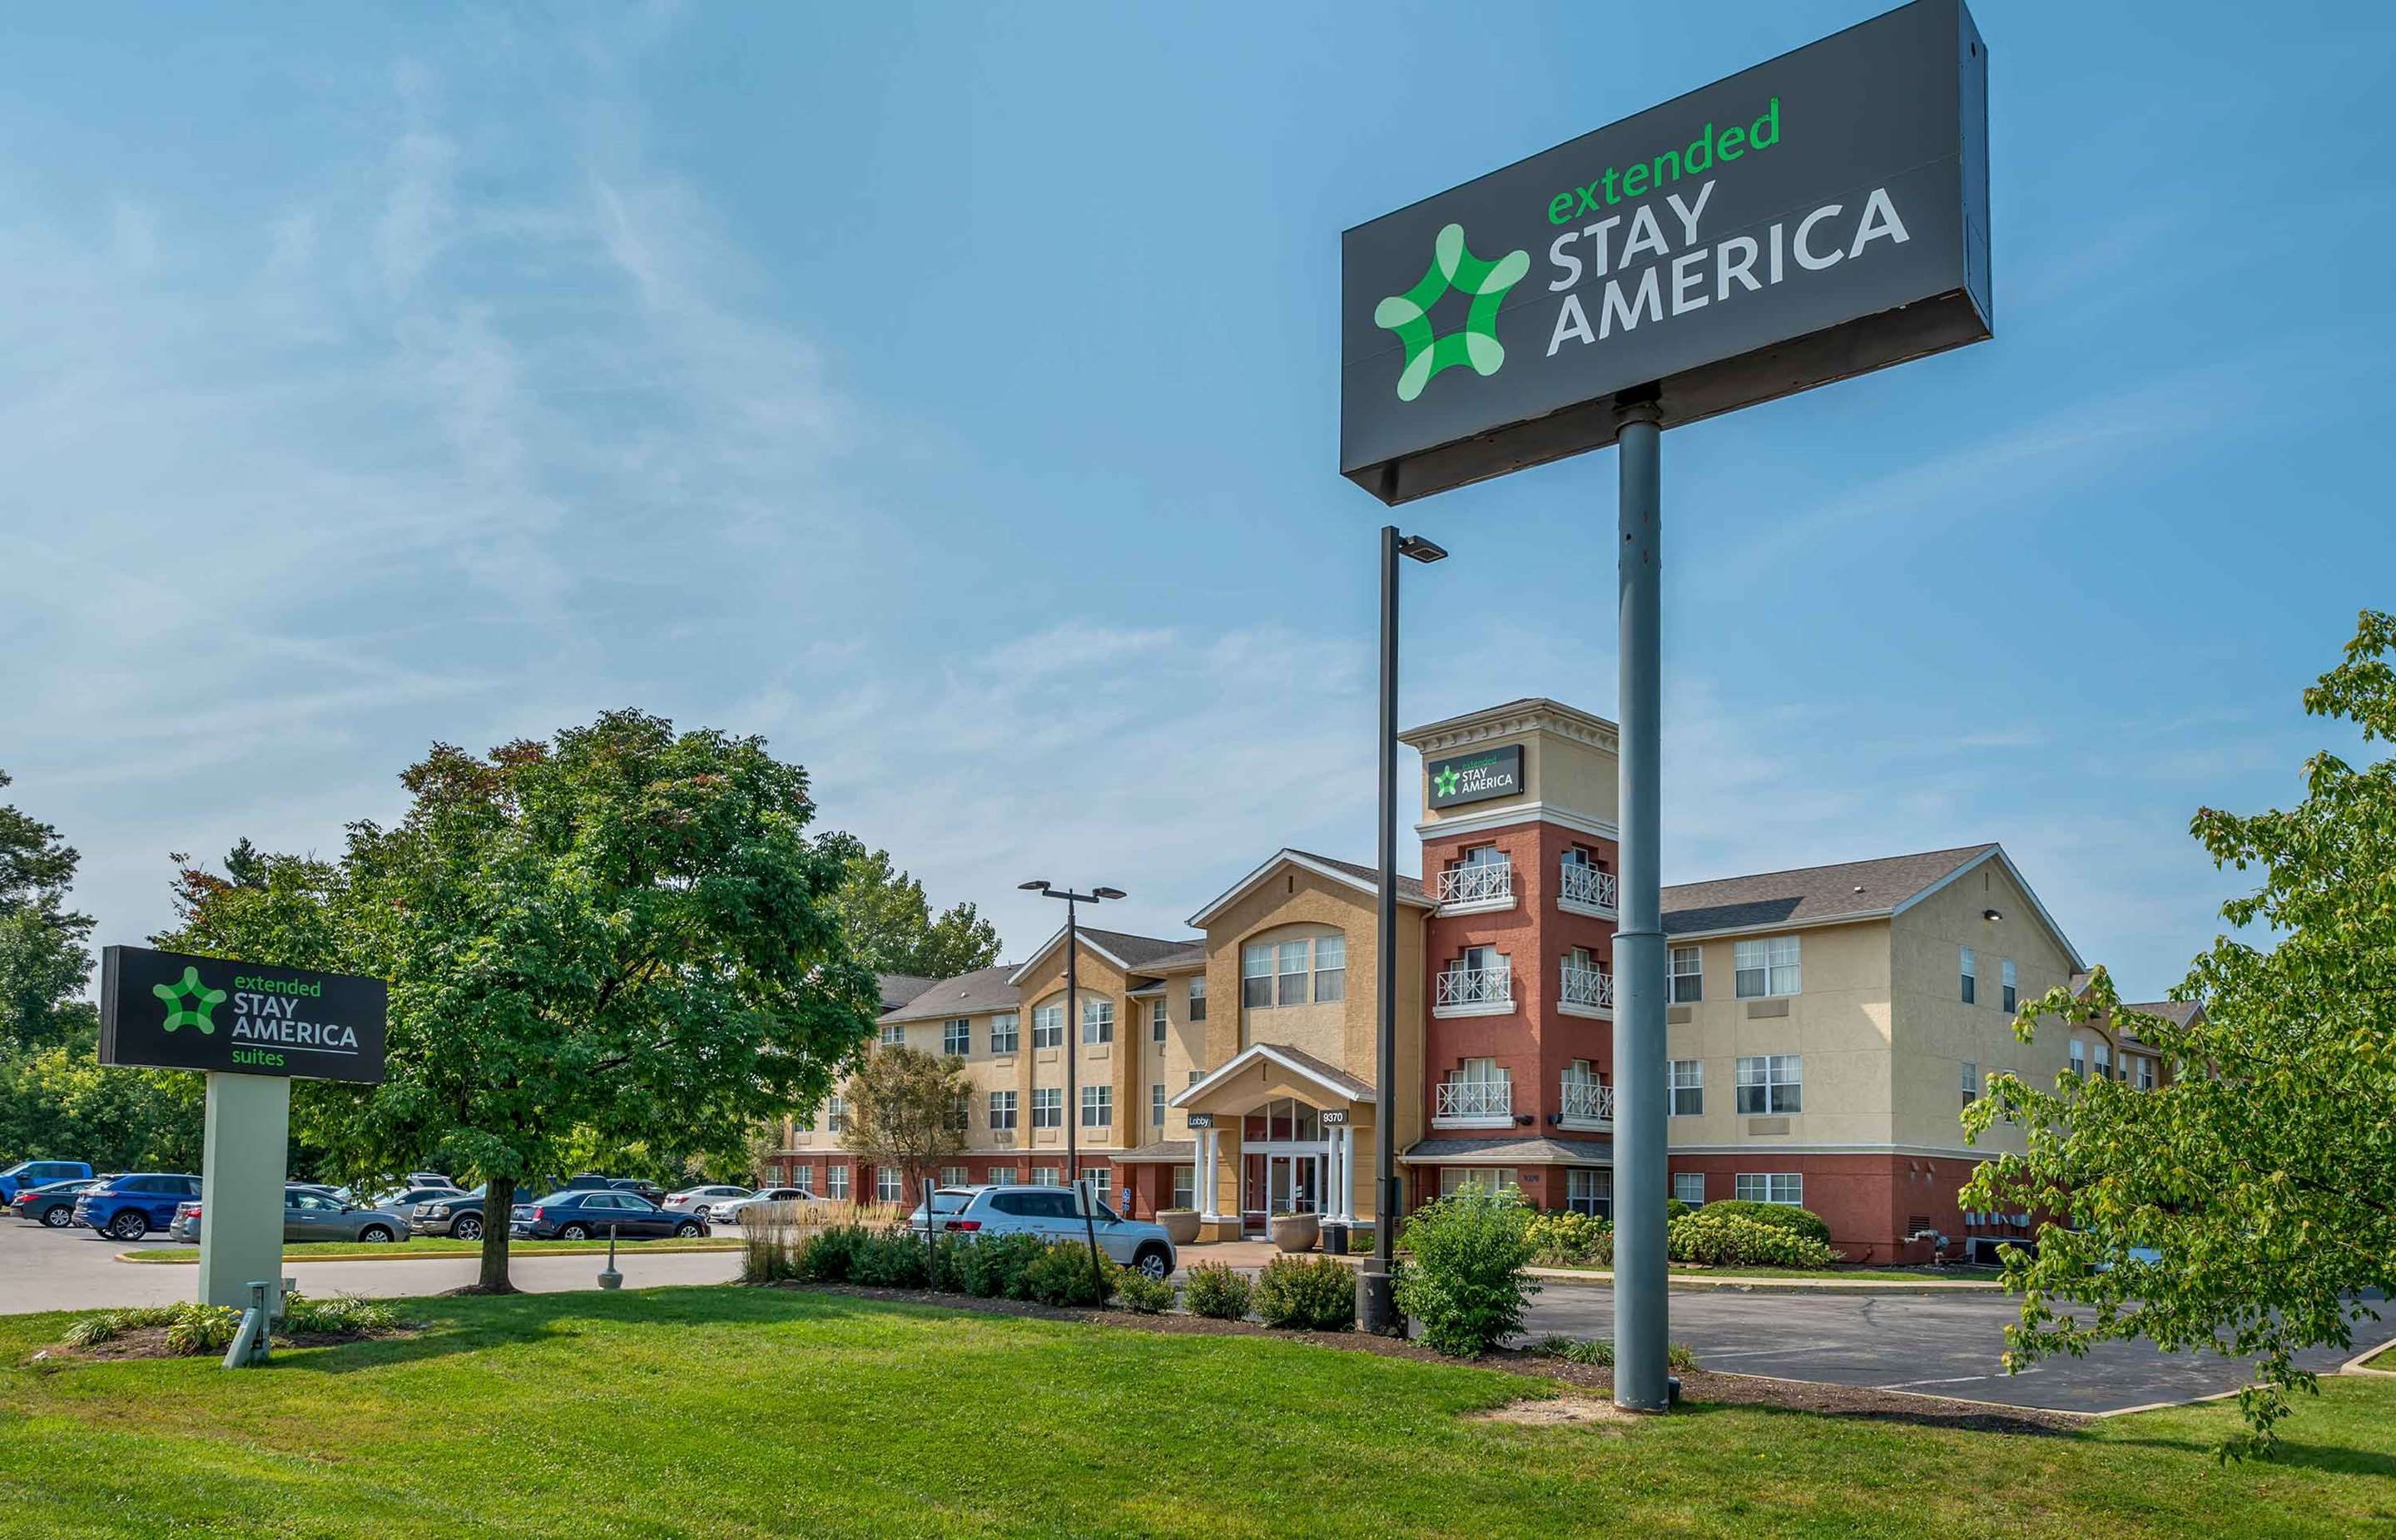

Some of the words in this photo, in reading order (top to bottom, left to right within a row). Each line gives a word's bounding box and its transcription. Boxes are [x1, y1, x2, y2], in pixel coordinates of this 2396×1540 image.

[1547, 97, 1780, 225] extended
[1548, 179, 1716, 292] STAY
[1545, 186, 1910, 358] AMERICA
[1461, 774, 1512, 793] AMERICA
[1462, 767, 1487, 782] STAY
[234, 975, 320, 997] extended
[234, 993, 298, 1018] STAY
[231, 1016, 358, 1047] AMERICA
[232, 1048, 285, 1066] suites
[1189, 1117, 1209, 1128] Lobby
[1323, 1112, 1343, 1122] 9370
